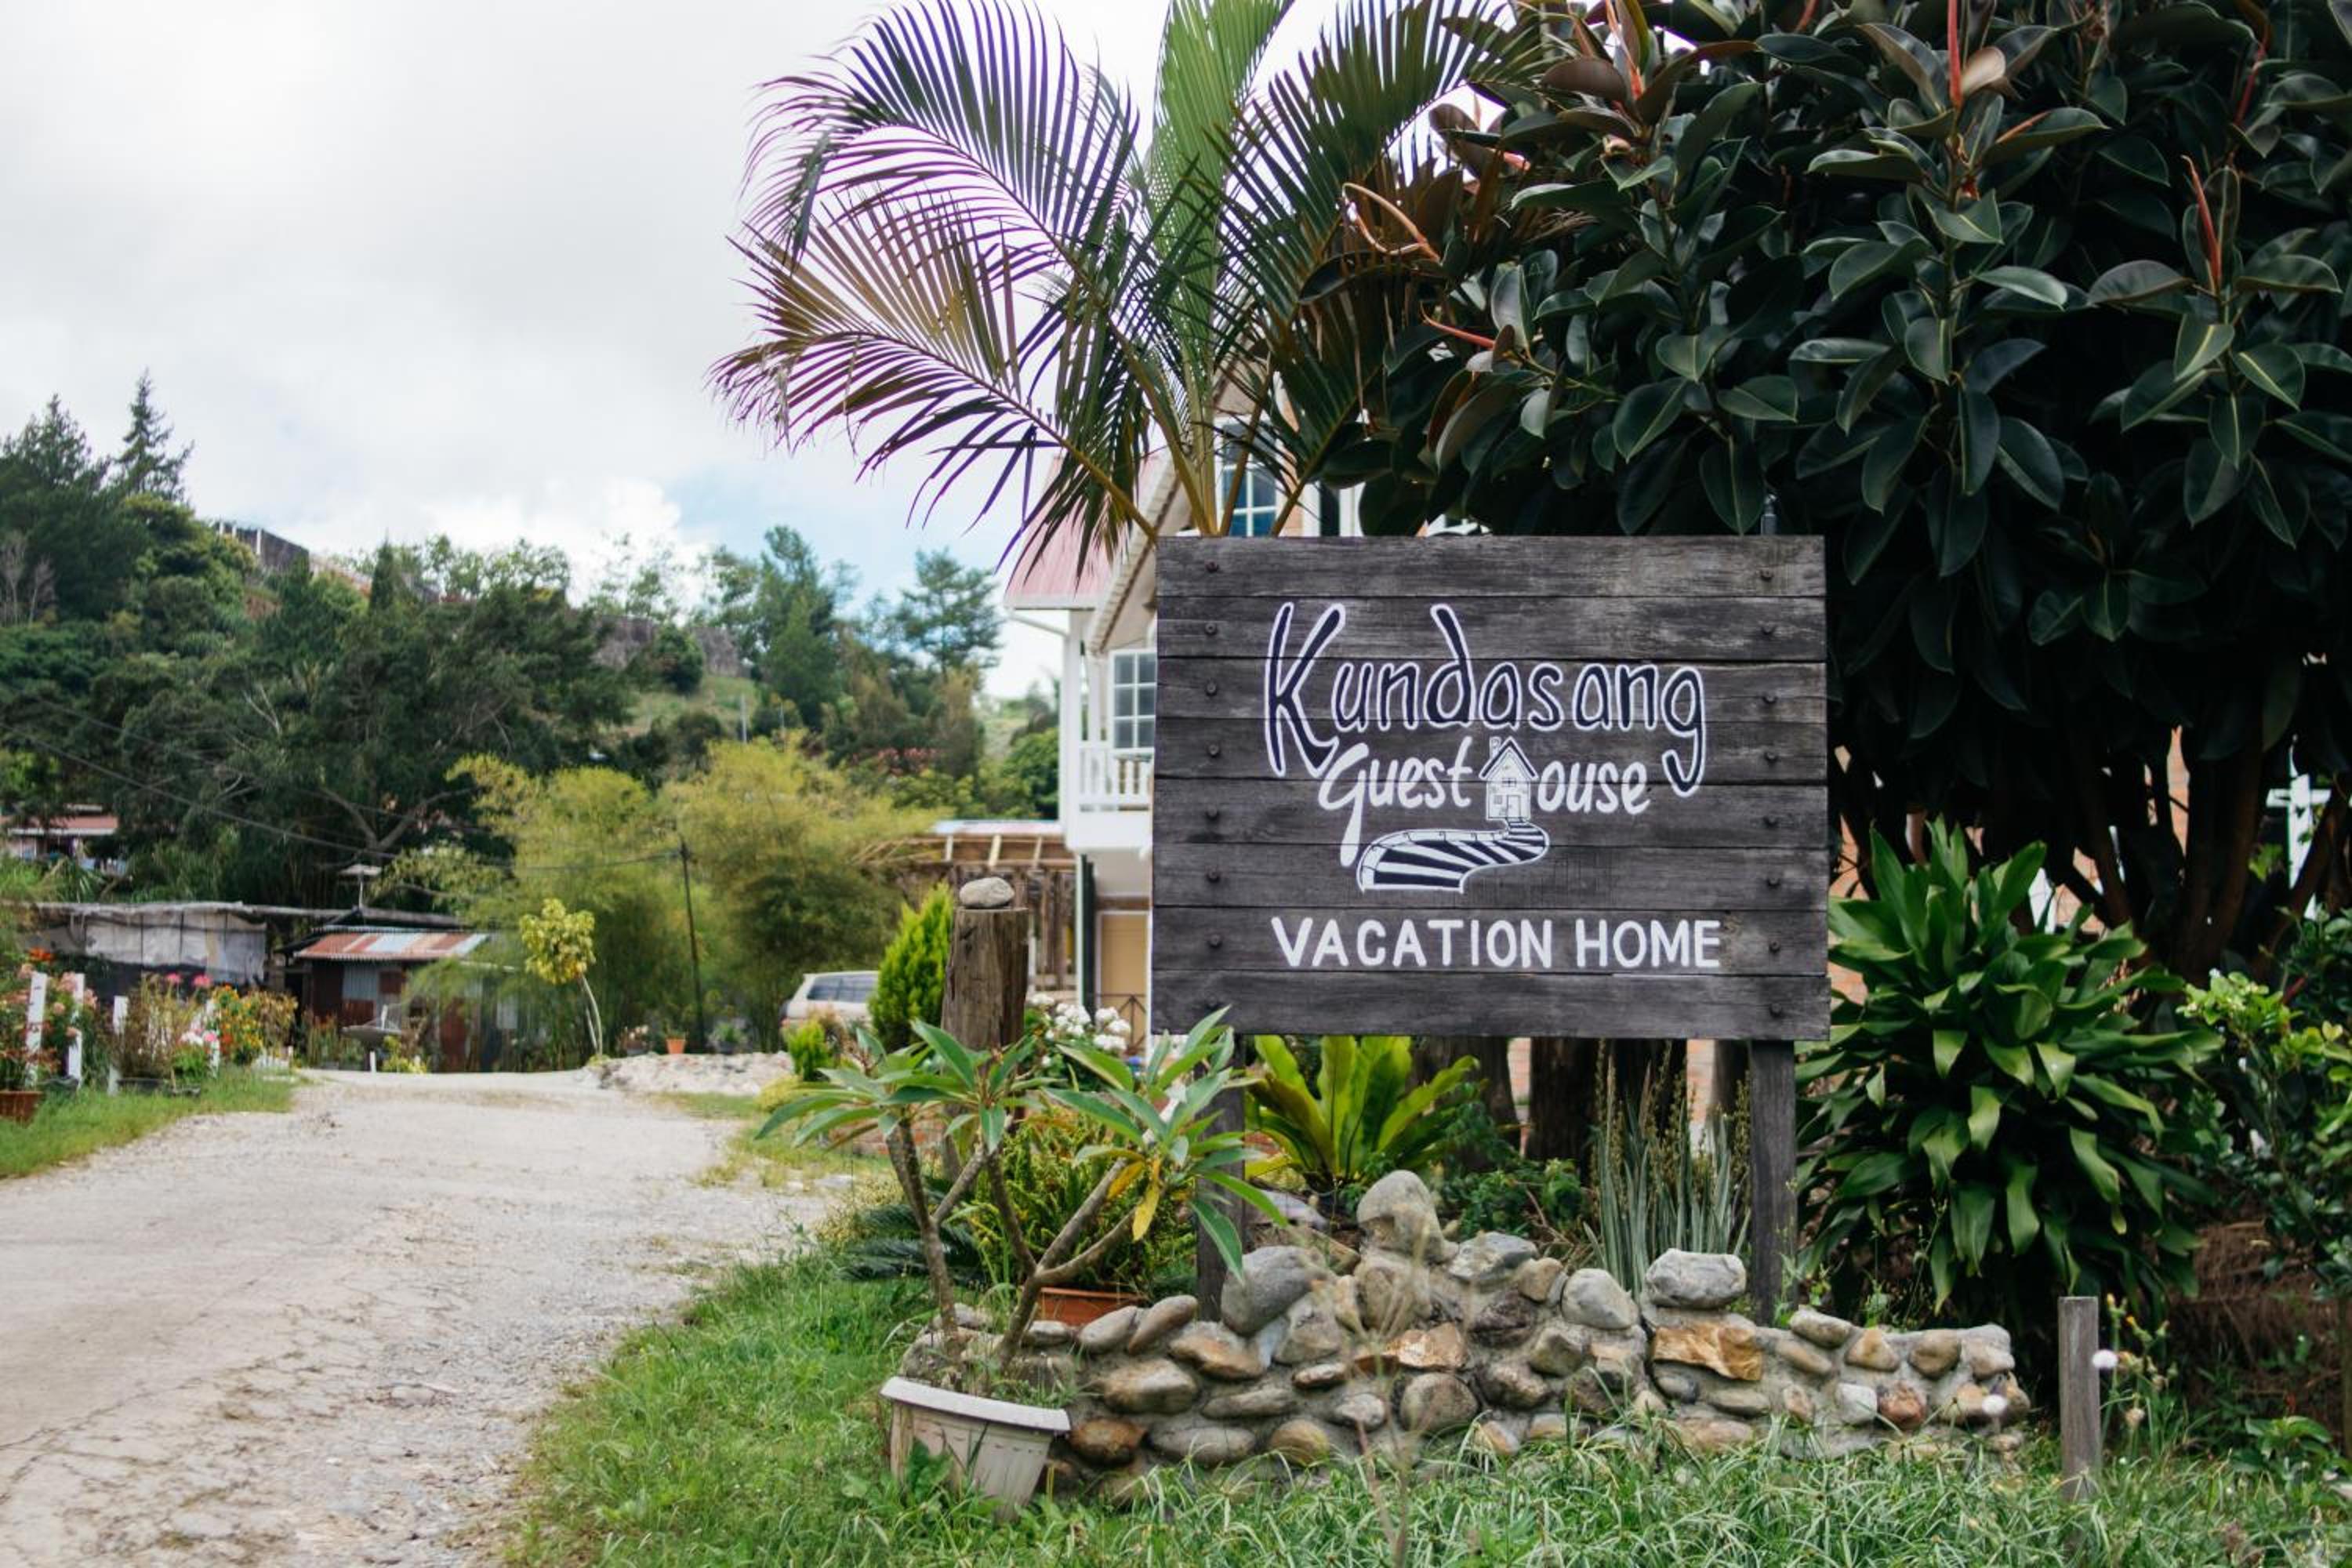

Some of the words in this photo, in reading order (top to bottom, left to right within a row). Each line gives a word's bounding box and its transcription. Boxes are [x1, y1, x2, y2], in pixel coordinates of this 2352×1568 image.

[1264, 602, 1707, 796] Kundasang
[1271, 916, 1554, 968] VACATION
[1576, 919, 1722, 968] HOME
